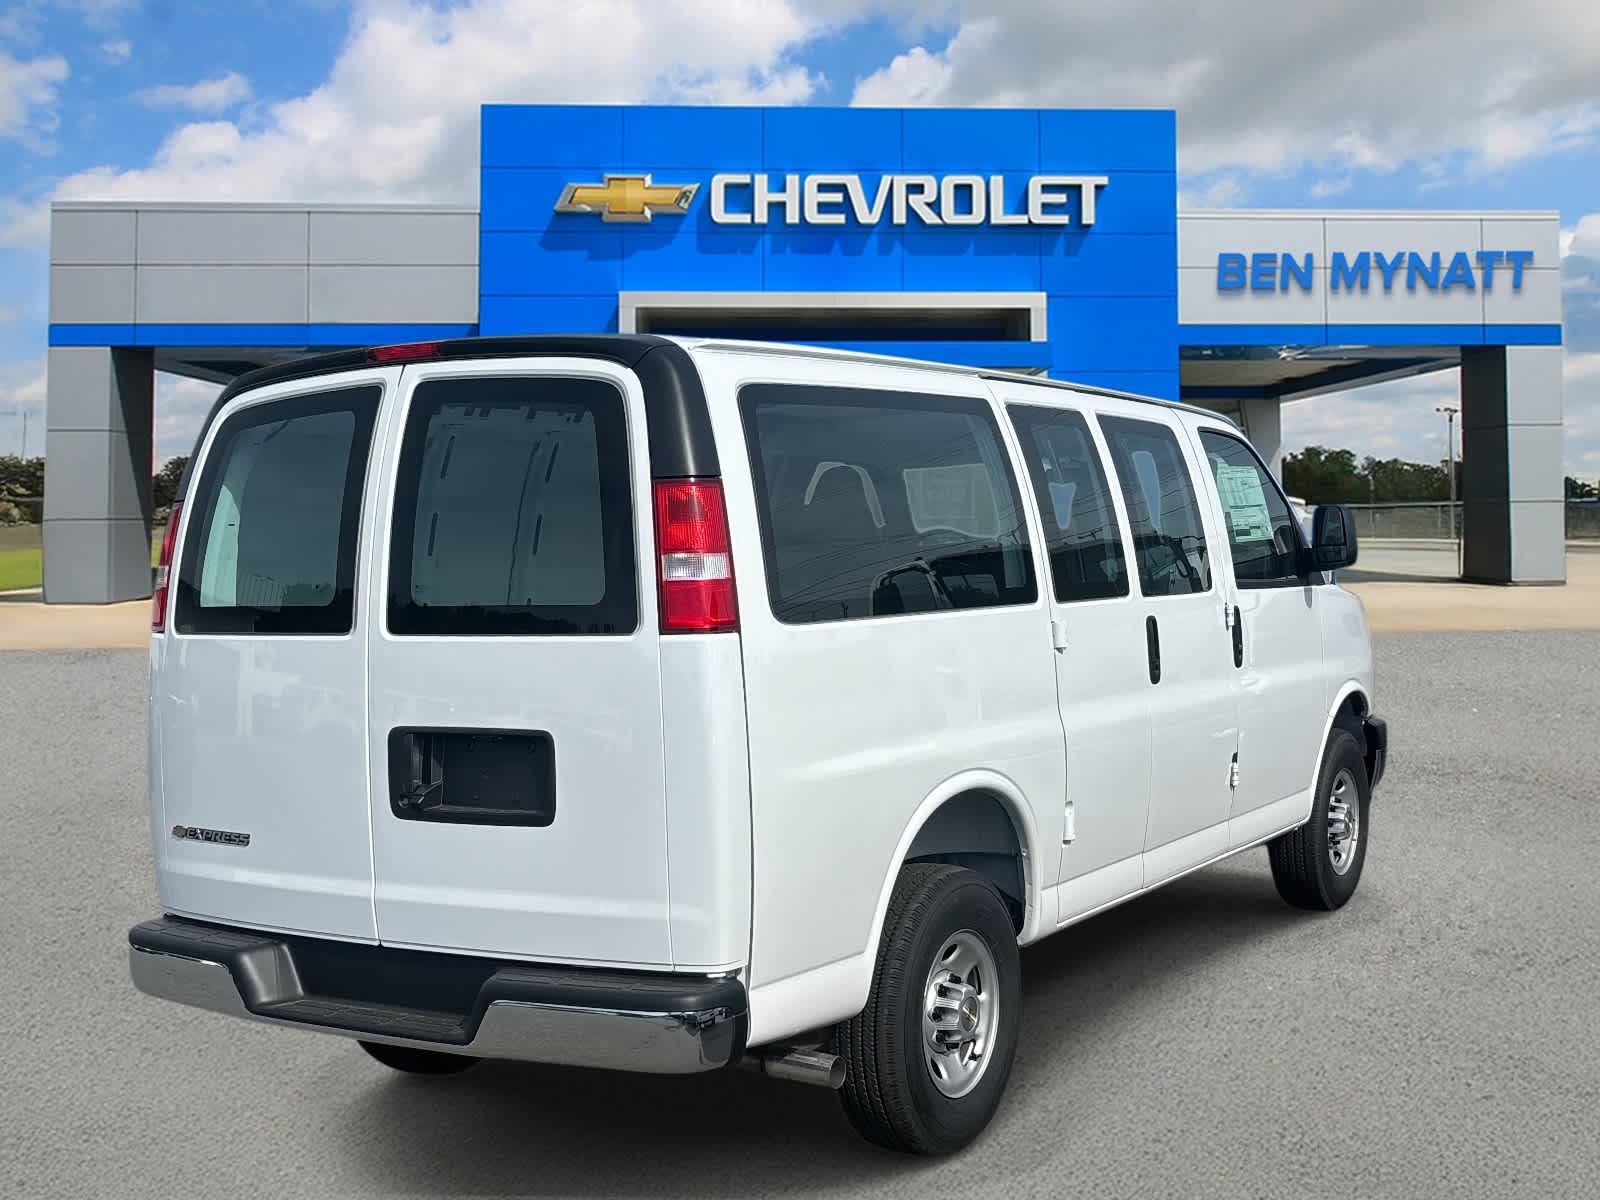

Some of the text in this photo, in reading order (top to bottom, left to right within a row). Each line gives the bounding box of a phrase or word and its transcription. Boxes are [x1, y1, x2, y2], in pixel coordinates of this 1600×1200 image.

[710, 174, 1109, 226] CHEVROLET
[1217, 250, 1534, 291] BEN MYNATT
[186, 827, 250, 846] EXPRESS
